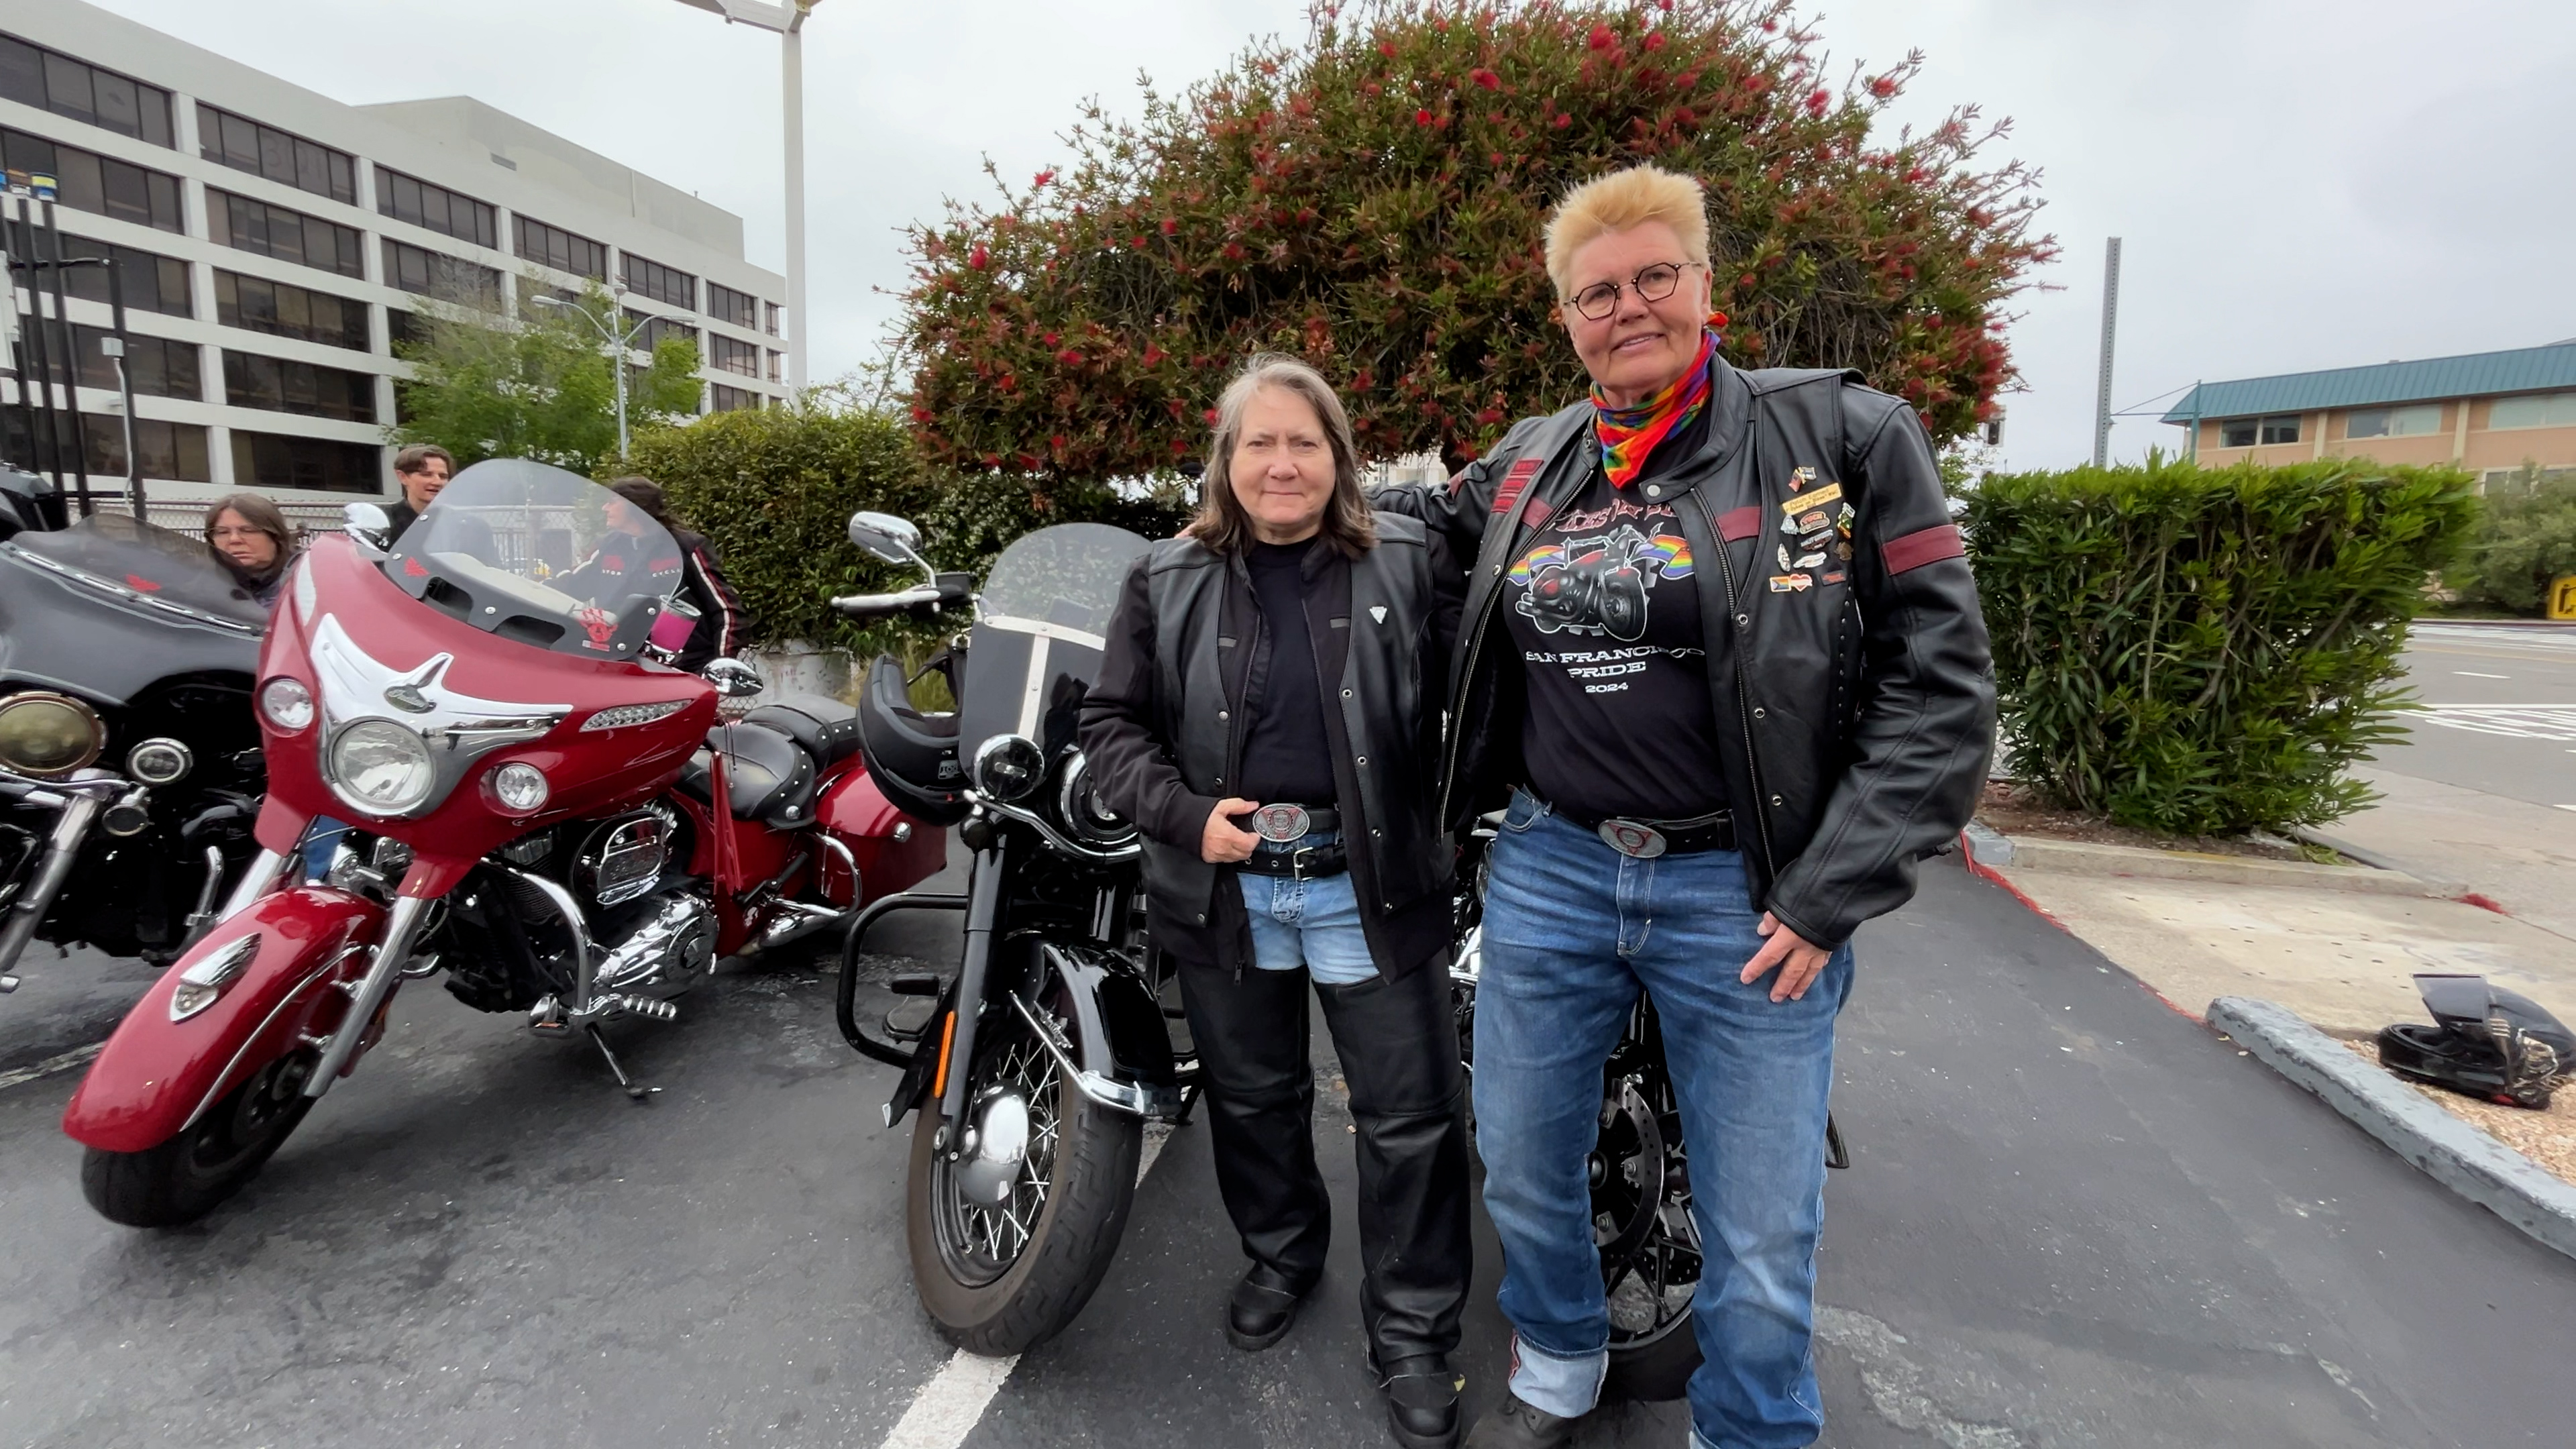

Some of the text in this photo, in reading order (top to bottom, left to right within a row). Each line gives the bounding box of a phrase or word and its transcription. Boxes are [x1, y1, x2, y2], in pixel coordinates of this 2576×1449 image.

[1525, 651, 1558, 663] SAN
[1567, 661, 1646, 679] PRIDE
[1585, 682, 1629, 693] 2024
